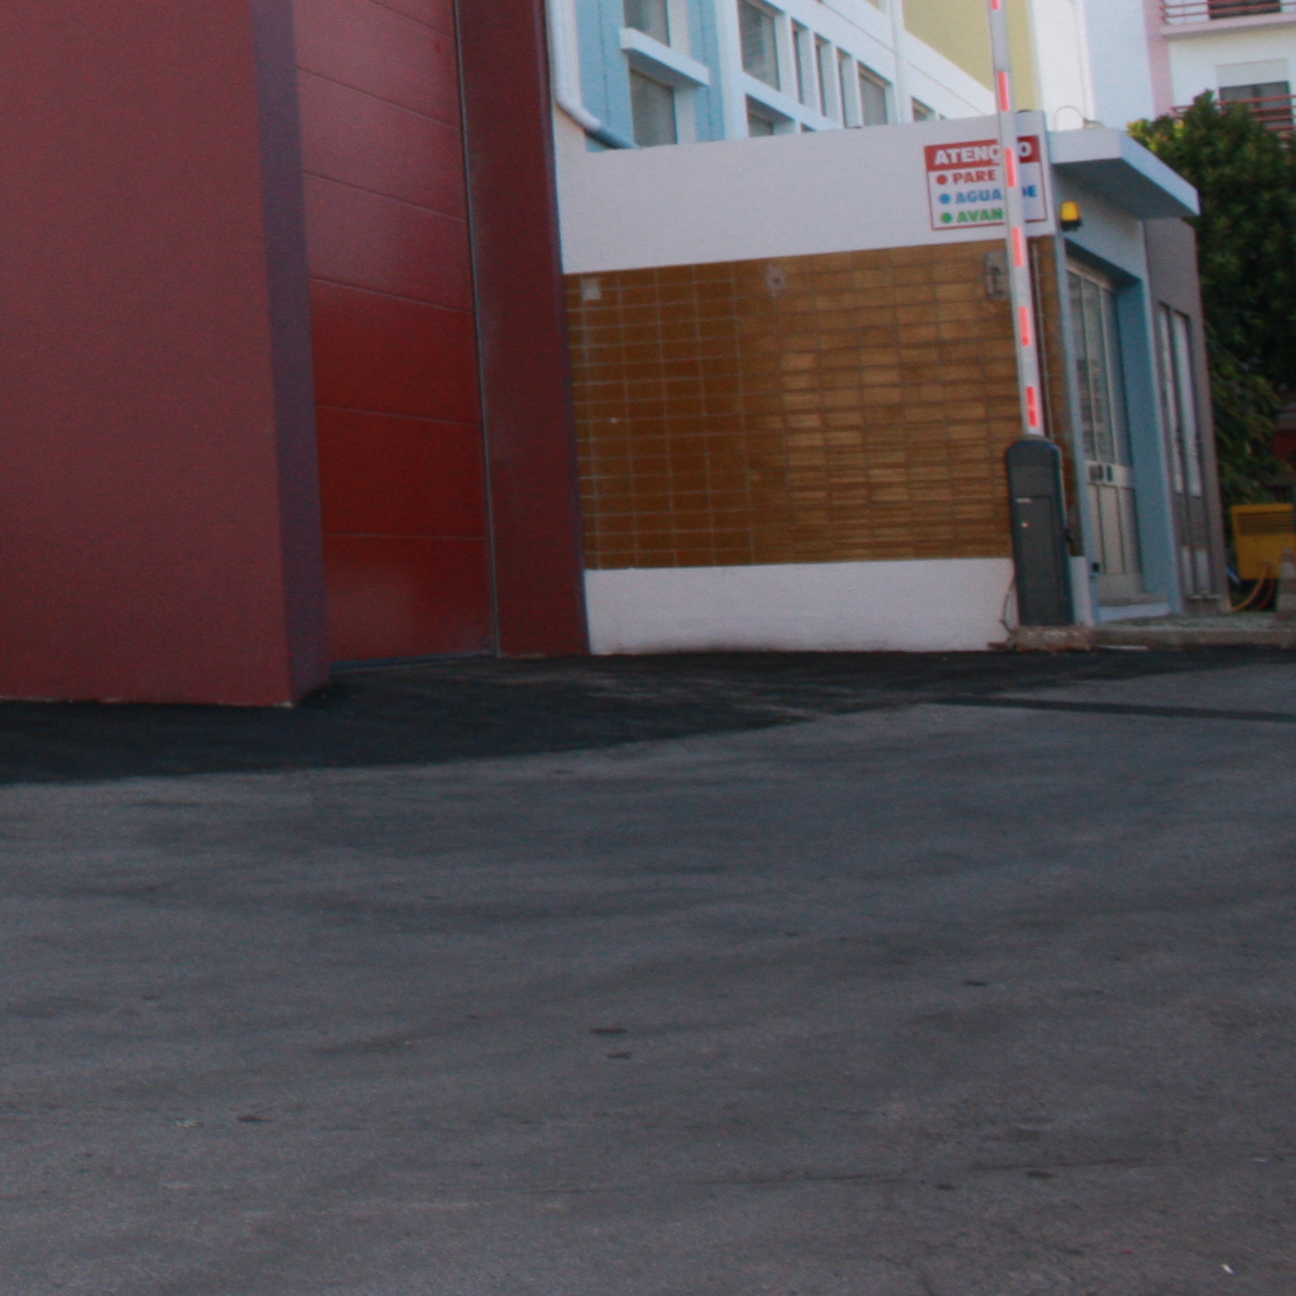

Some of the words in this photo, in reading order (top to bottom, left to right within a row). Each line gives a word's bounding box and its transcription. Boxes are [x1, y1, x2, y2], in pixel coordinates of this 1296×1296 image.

[934, 142, 1032, 166] ATENÇO
[953, 169, 996, 184] PARE
[956, 208, 1005, 223] AVAN
